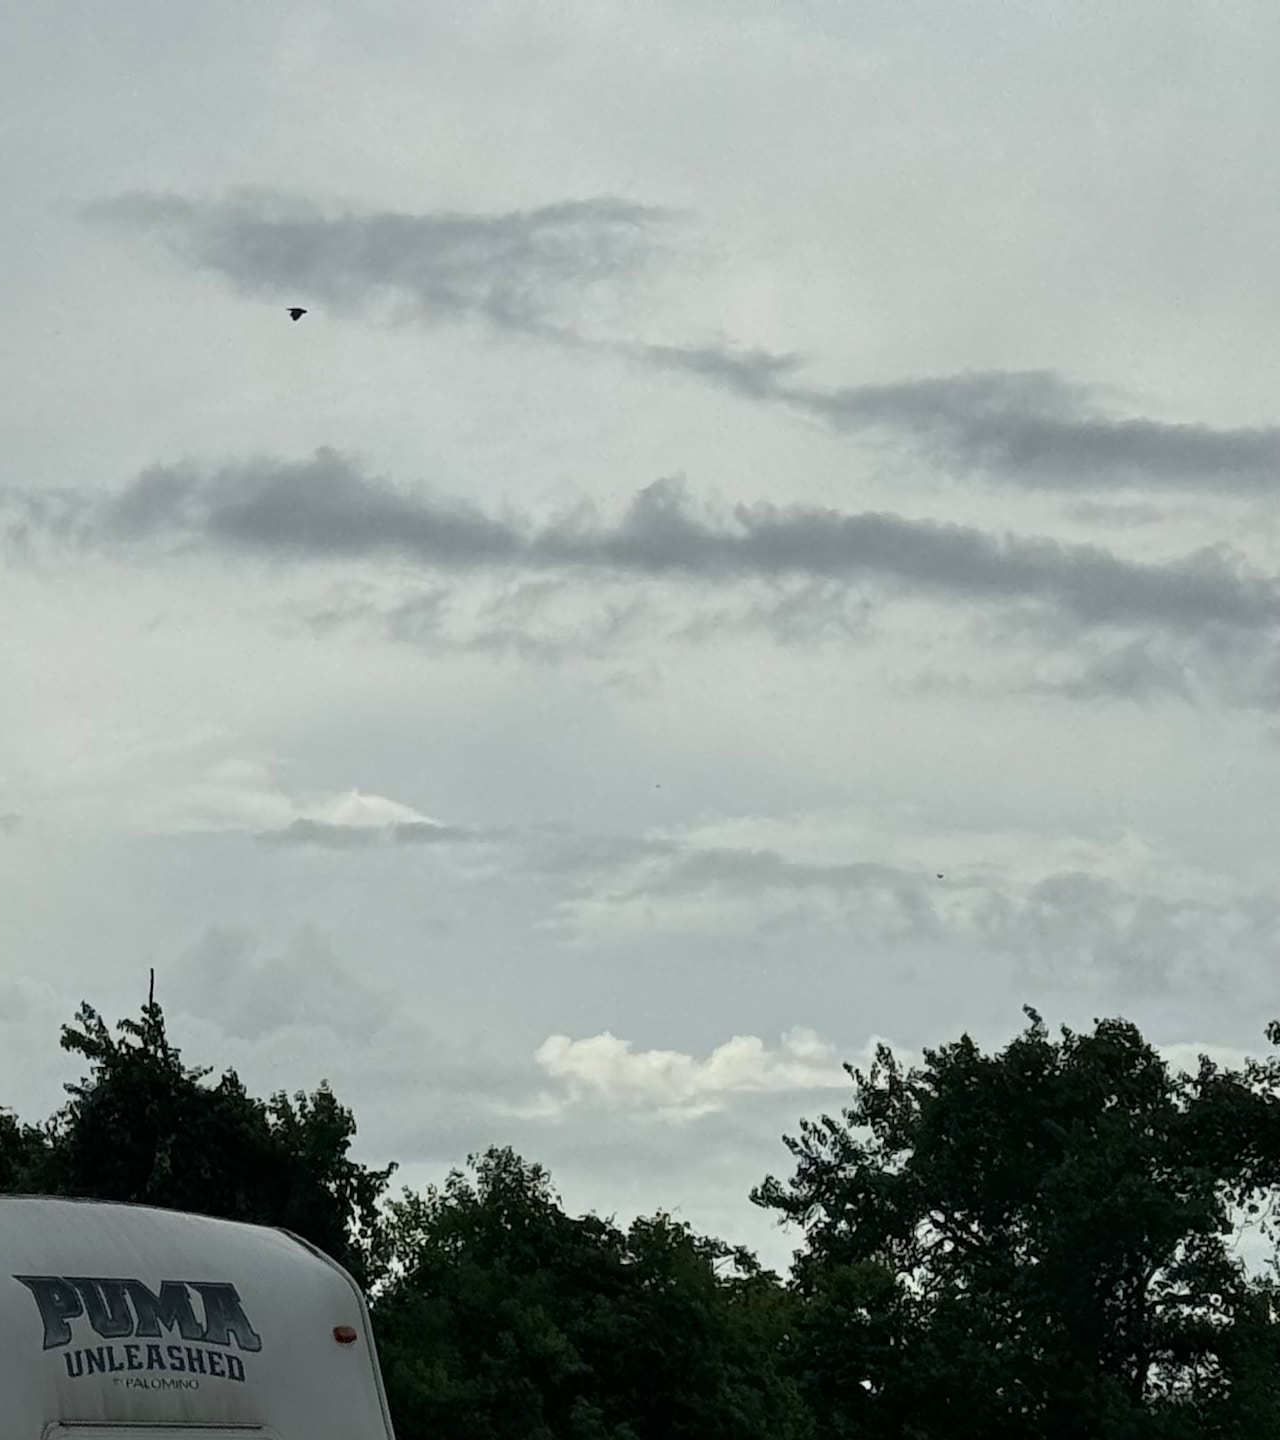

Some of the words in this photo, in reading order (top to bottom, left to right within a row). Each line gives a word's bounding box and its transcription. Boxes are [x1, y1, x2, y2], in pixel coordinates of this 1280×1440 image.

[12, 1275, 262, 1352] PUMA
[64, 1344, 246, 1383] UNLEASHED
[126, 1377, 200, 1390] PALOMINO
